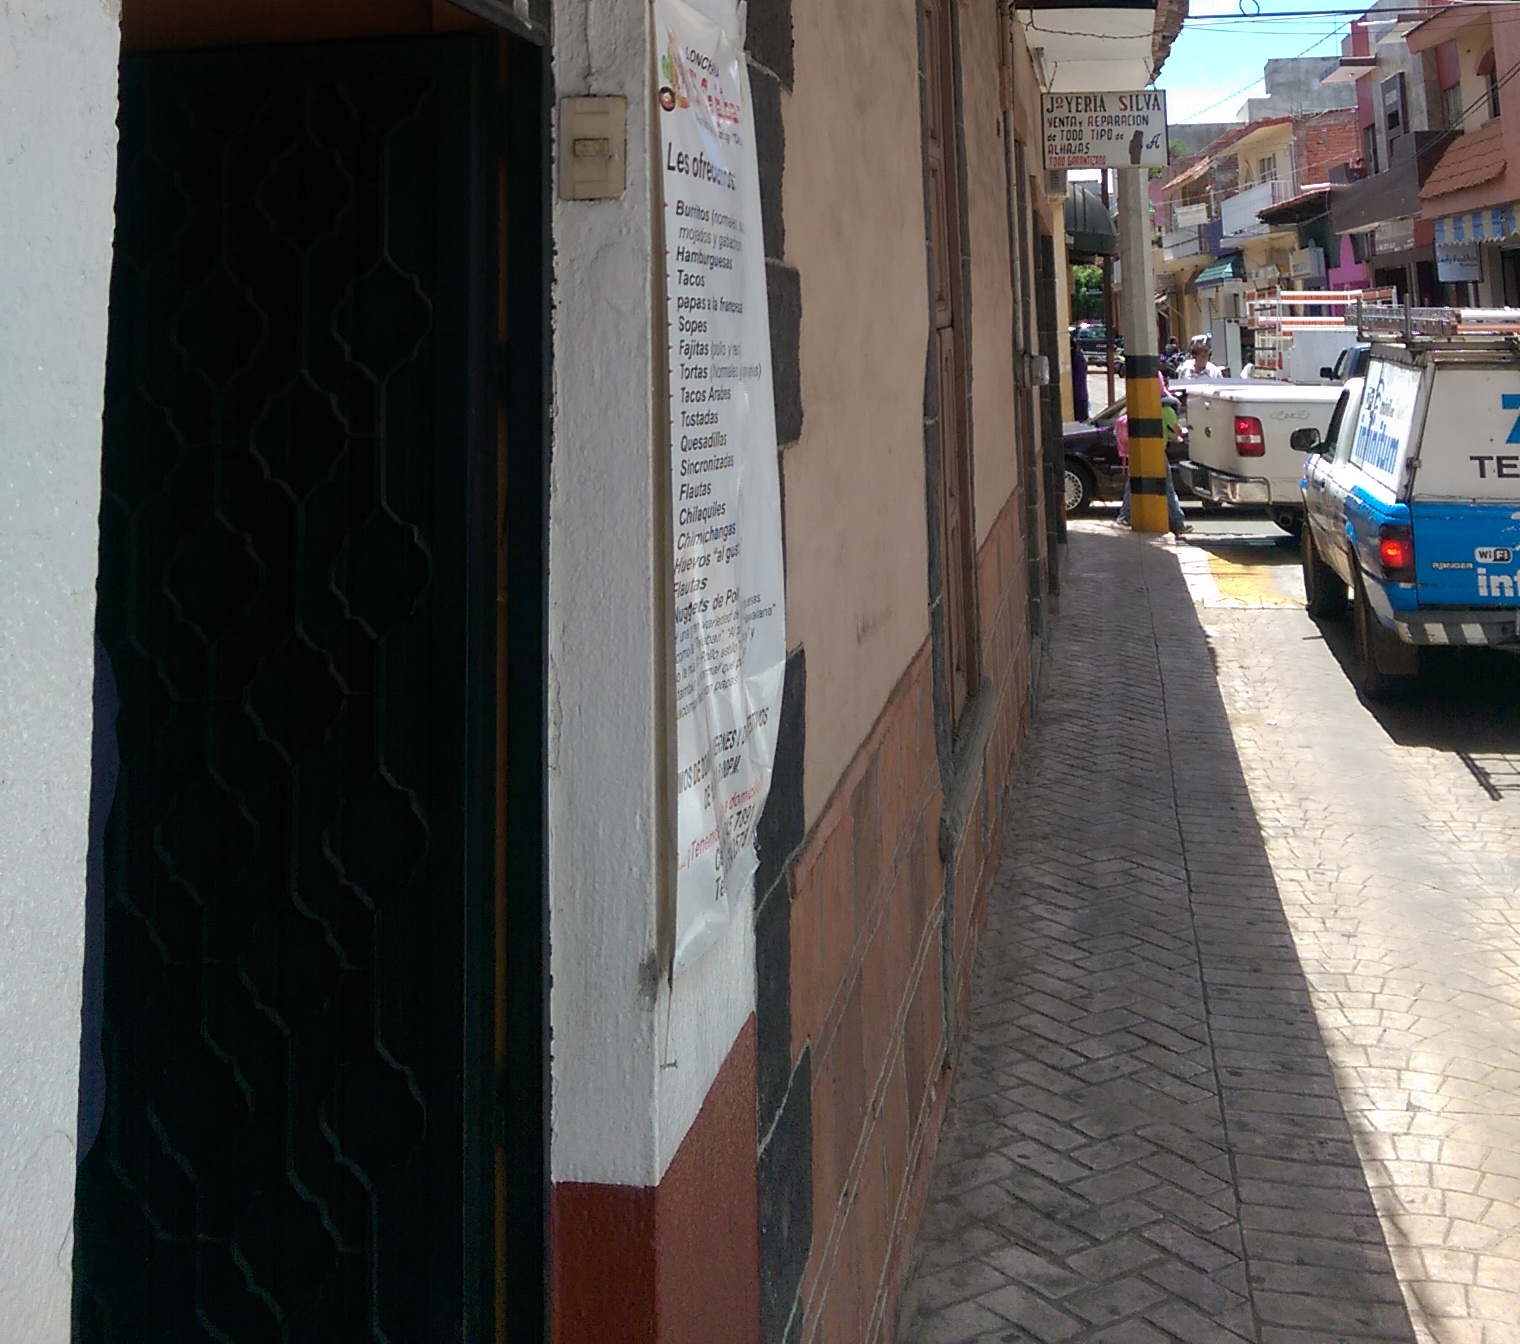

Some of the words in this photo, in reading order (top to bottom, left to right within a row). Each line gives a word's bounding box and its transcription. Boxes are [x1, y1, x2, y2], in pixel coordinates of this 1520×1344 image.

[1046, 94, 1106, 113] JOYERIA
[1118, 93, 1161, 112] SILVA
[1047, 116, 1077, 128] VENTA
[1087, 114, 1149, 127] REPARACION
[1047, 133, 1056, 142] de
[1060, 129, 1084, 141] TODO
[1115, 133, 1124, 141] de
[667, 141, 690, 175] Les
[1047, 142, 1091, 155] ALHAJAS
[676, 199, 710, 223] Burritos
[676, 245, 733, 271] Hamburguesas
[677, 268, 705, 287] Tacos
[677, 296, 706, 313] papas
[678, 315, 708, 336] Sopes
[678, 339, 710, 360] Fajitas
[679, 362, 709, 380] Tortas
[680, 386, 707, 403] Tacos
[680, 408, 719, 427] Tostadas
[680, 431, 727, 452] Quesadillas
[679, 452, 734, 477] Sincronizadas
[678, 481, 712, 501] Flautas
[679, 500, 726, 526] Chilaquiles
[674, 552, 711, 575] Huevos
[673, 576, 708, 598] Flautas
